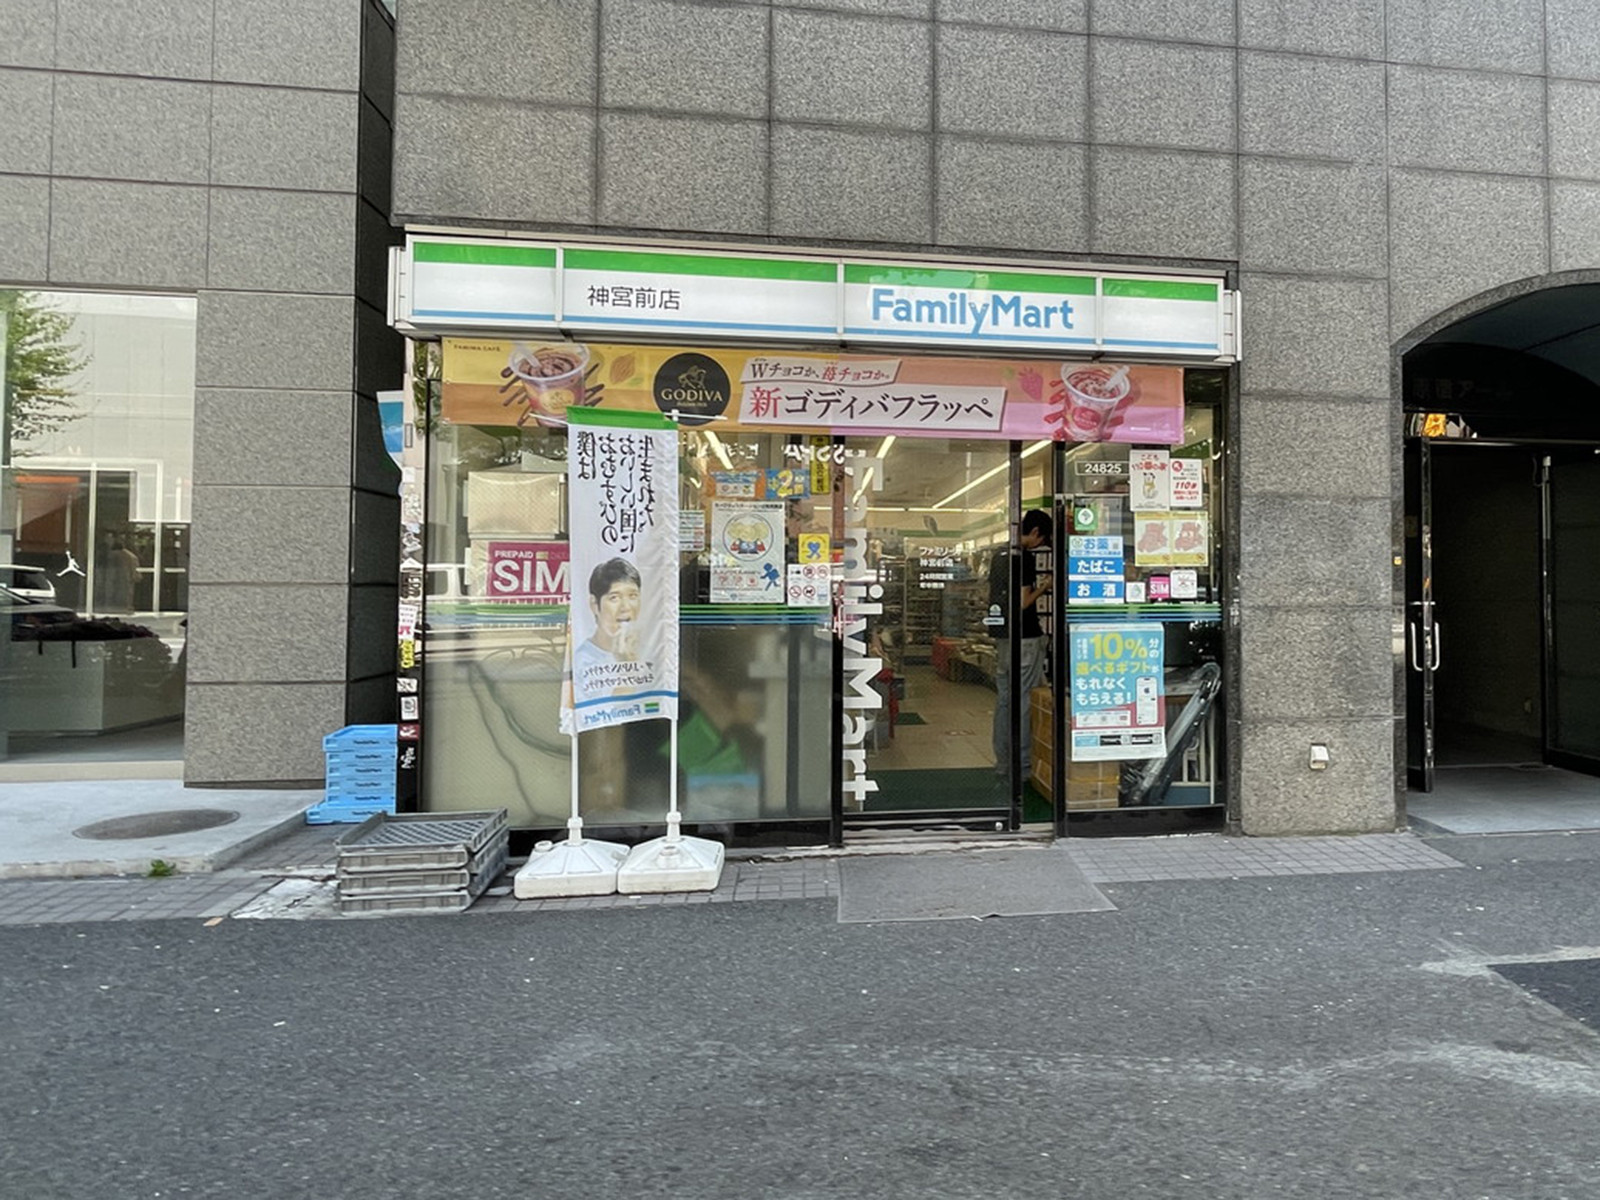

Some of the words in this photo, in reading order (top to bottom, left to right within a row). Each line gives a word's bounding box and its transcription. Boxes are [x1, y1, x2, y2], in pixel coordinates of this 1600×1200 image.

[587, 285, 681, 311] 神宮前店
[872, 289, 1074, 335] FamilyMart
[660, 388, 723, 402] GODIVA
[749, 385, 994, 422] 新ゴディバフラッペ
[1084, 463, 1123, 474] 24825
[494, 550, 534, 559] PREPAID
[1077, 559, 1116, 574] たばこ
[492, 559, 571, 594] SIM
[1150, 584, 1169, 595] SIM
[1076, 677, 1126, 690] もれなく
